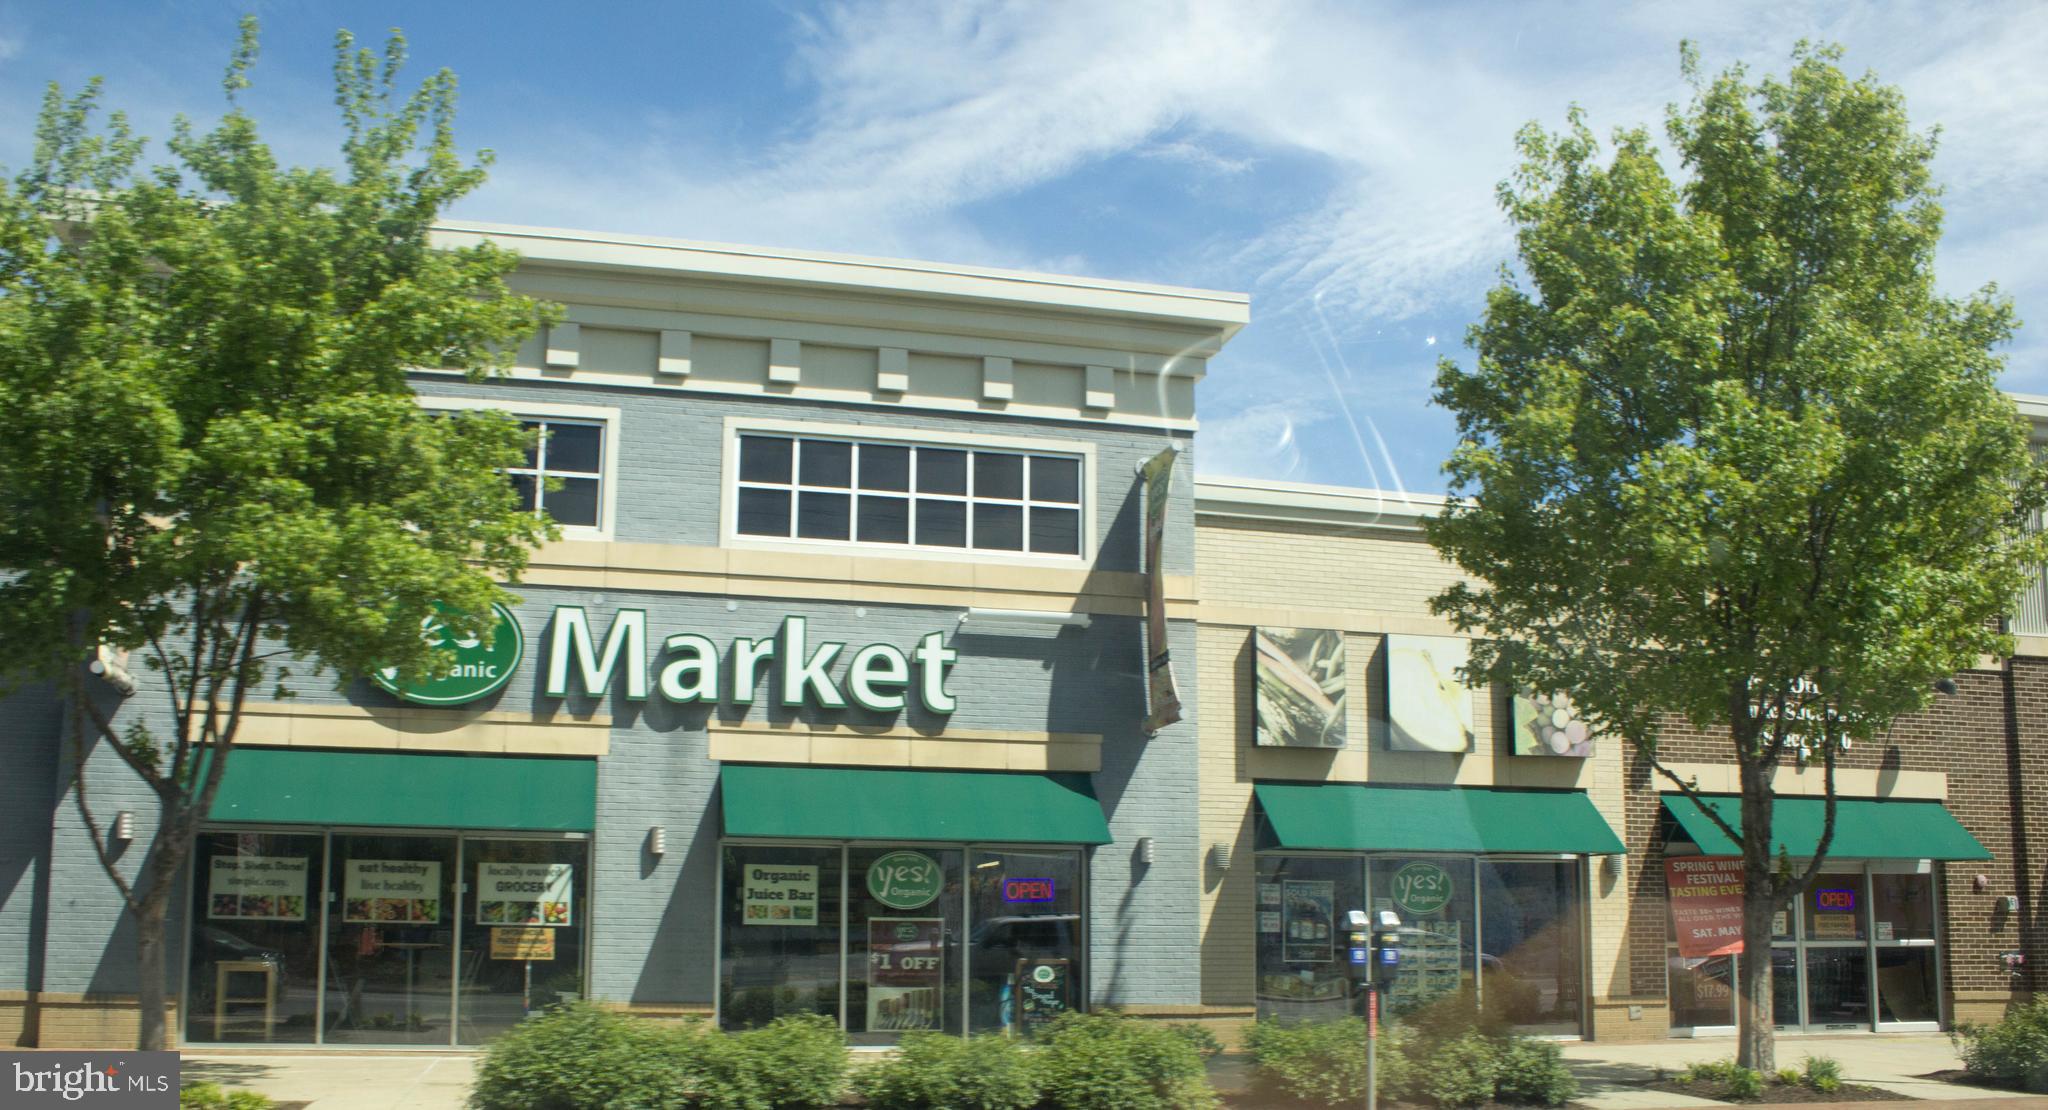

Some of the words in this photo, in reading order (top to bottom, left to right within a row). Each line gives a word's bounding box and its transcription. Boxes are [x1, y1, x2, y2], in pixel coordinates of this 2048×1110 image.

[546, 604, 958, 715] Market
[358, 863, 379, 873] eat
[382, 862, 429, 877] healthy
[1673, 861, 1714, 872] SPRING
[752, 868, 811, 884] Organic
[877, 863, 932, 898] yes!
[1686, 873, 1740, 885] FESTIVAL
[384, 879, 424, 894] healthy
[496, 881, 552, 893] GROCERY
[747, 887, 784, 900] Juice
[788, 888, 816, 900] Bar
[891, 886, 932, 898] Organic
[1005, 881, 1052, 899] OPEN
[1398, 872, 1445, 905] yes!
[1669, 886, 1718, 897] TASTING
[1719, 884, 1744, 896] EVE
[1819, 891, 1853, 907] OPEN
[1692, 928, 1717, 938] SAT.
[1719, 926, 1742, 936] MAY
[870, 952, 893, 970] $1
[900, 957, 940, 970] OFF
